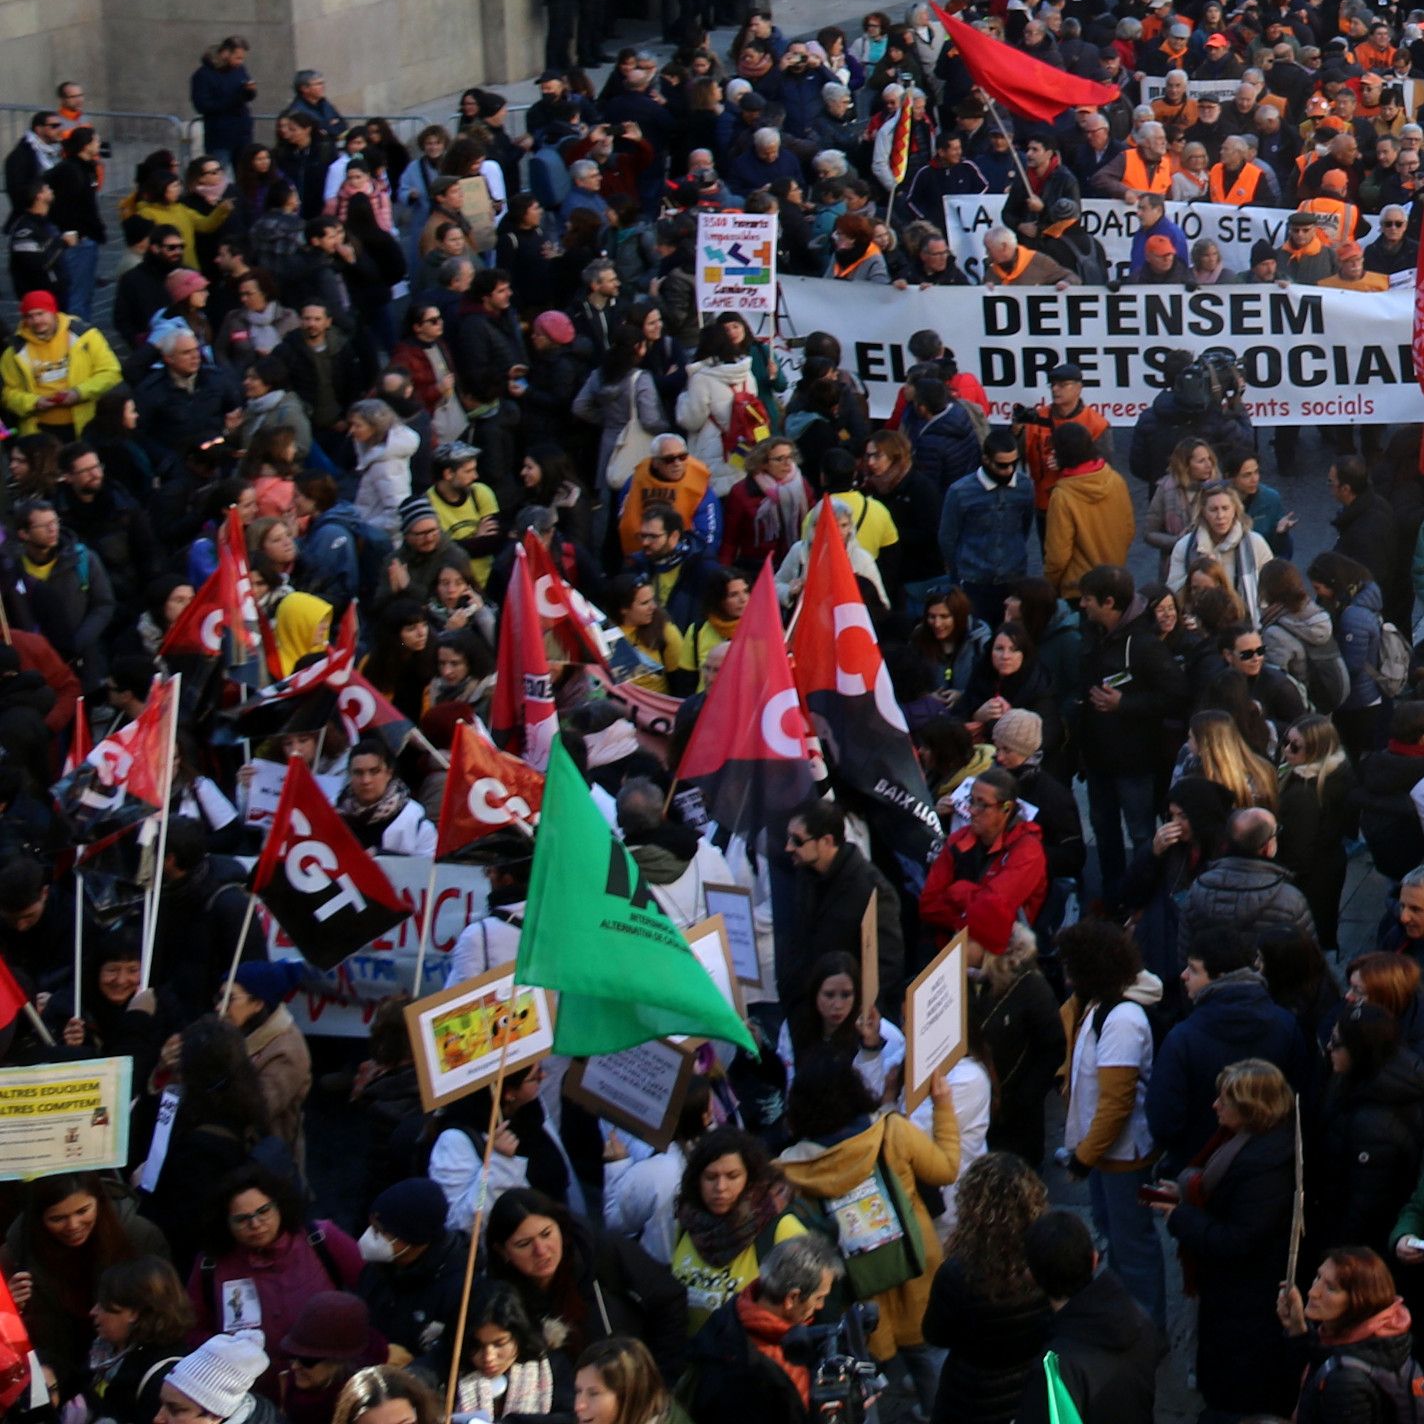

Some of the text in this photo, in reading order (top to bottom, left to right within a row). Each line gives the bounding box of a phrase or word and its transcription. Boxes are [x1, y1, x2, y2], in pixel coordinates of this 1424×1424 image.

[957, 206, 993, 232] LA
[1218, 216, 1251, 242] SE
[702, 296, 769, 309] GAME OVER
[983, 293, 1325, 337] DEFENSEM
[1301, 393, 1374, 417] socials
[874, 778, 915, 809] BAIX
[40, 1081, 100, 1098] EDUQUEM
